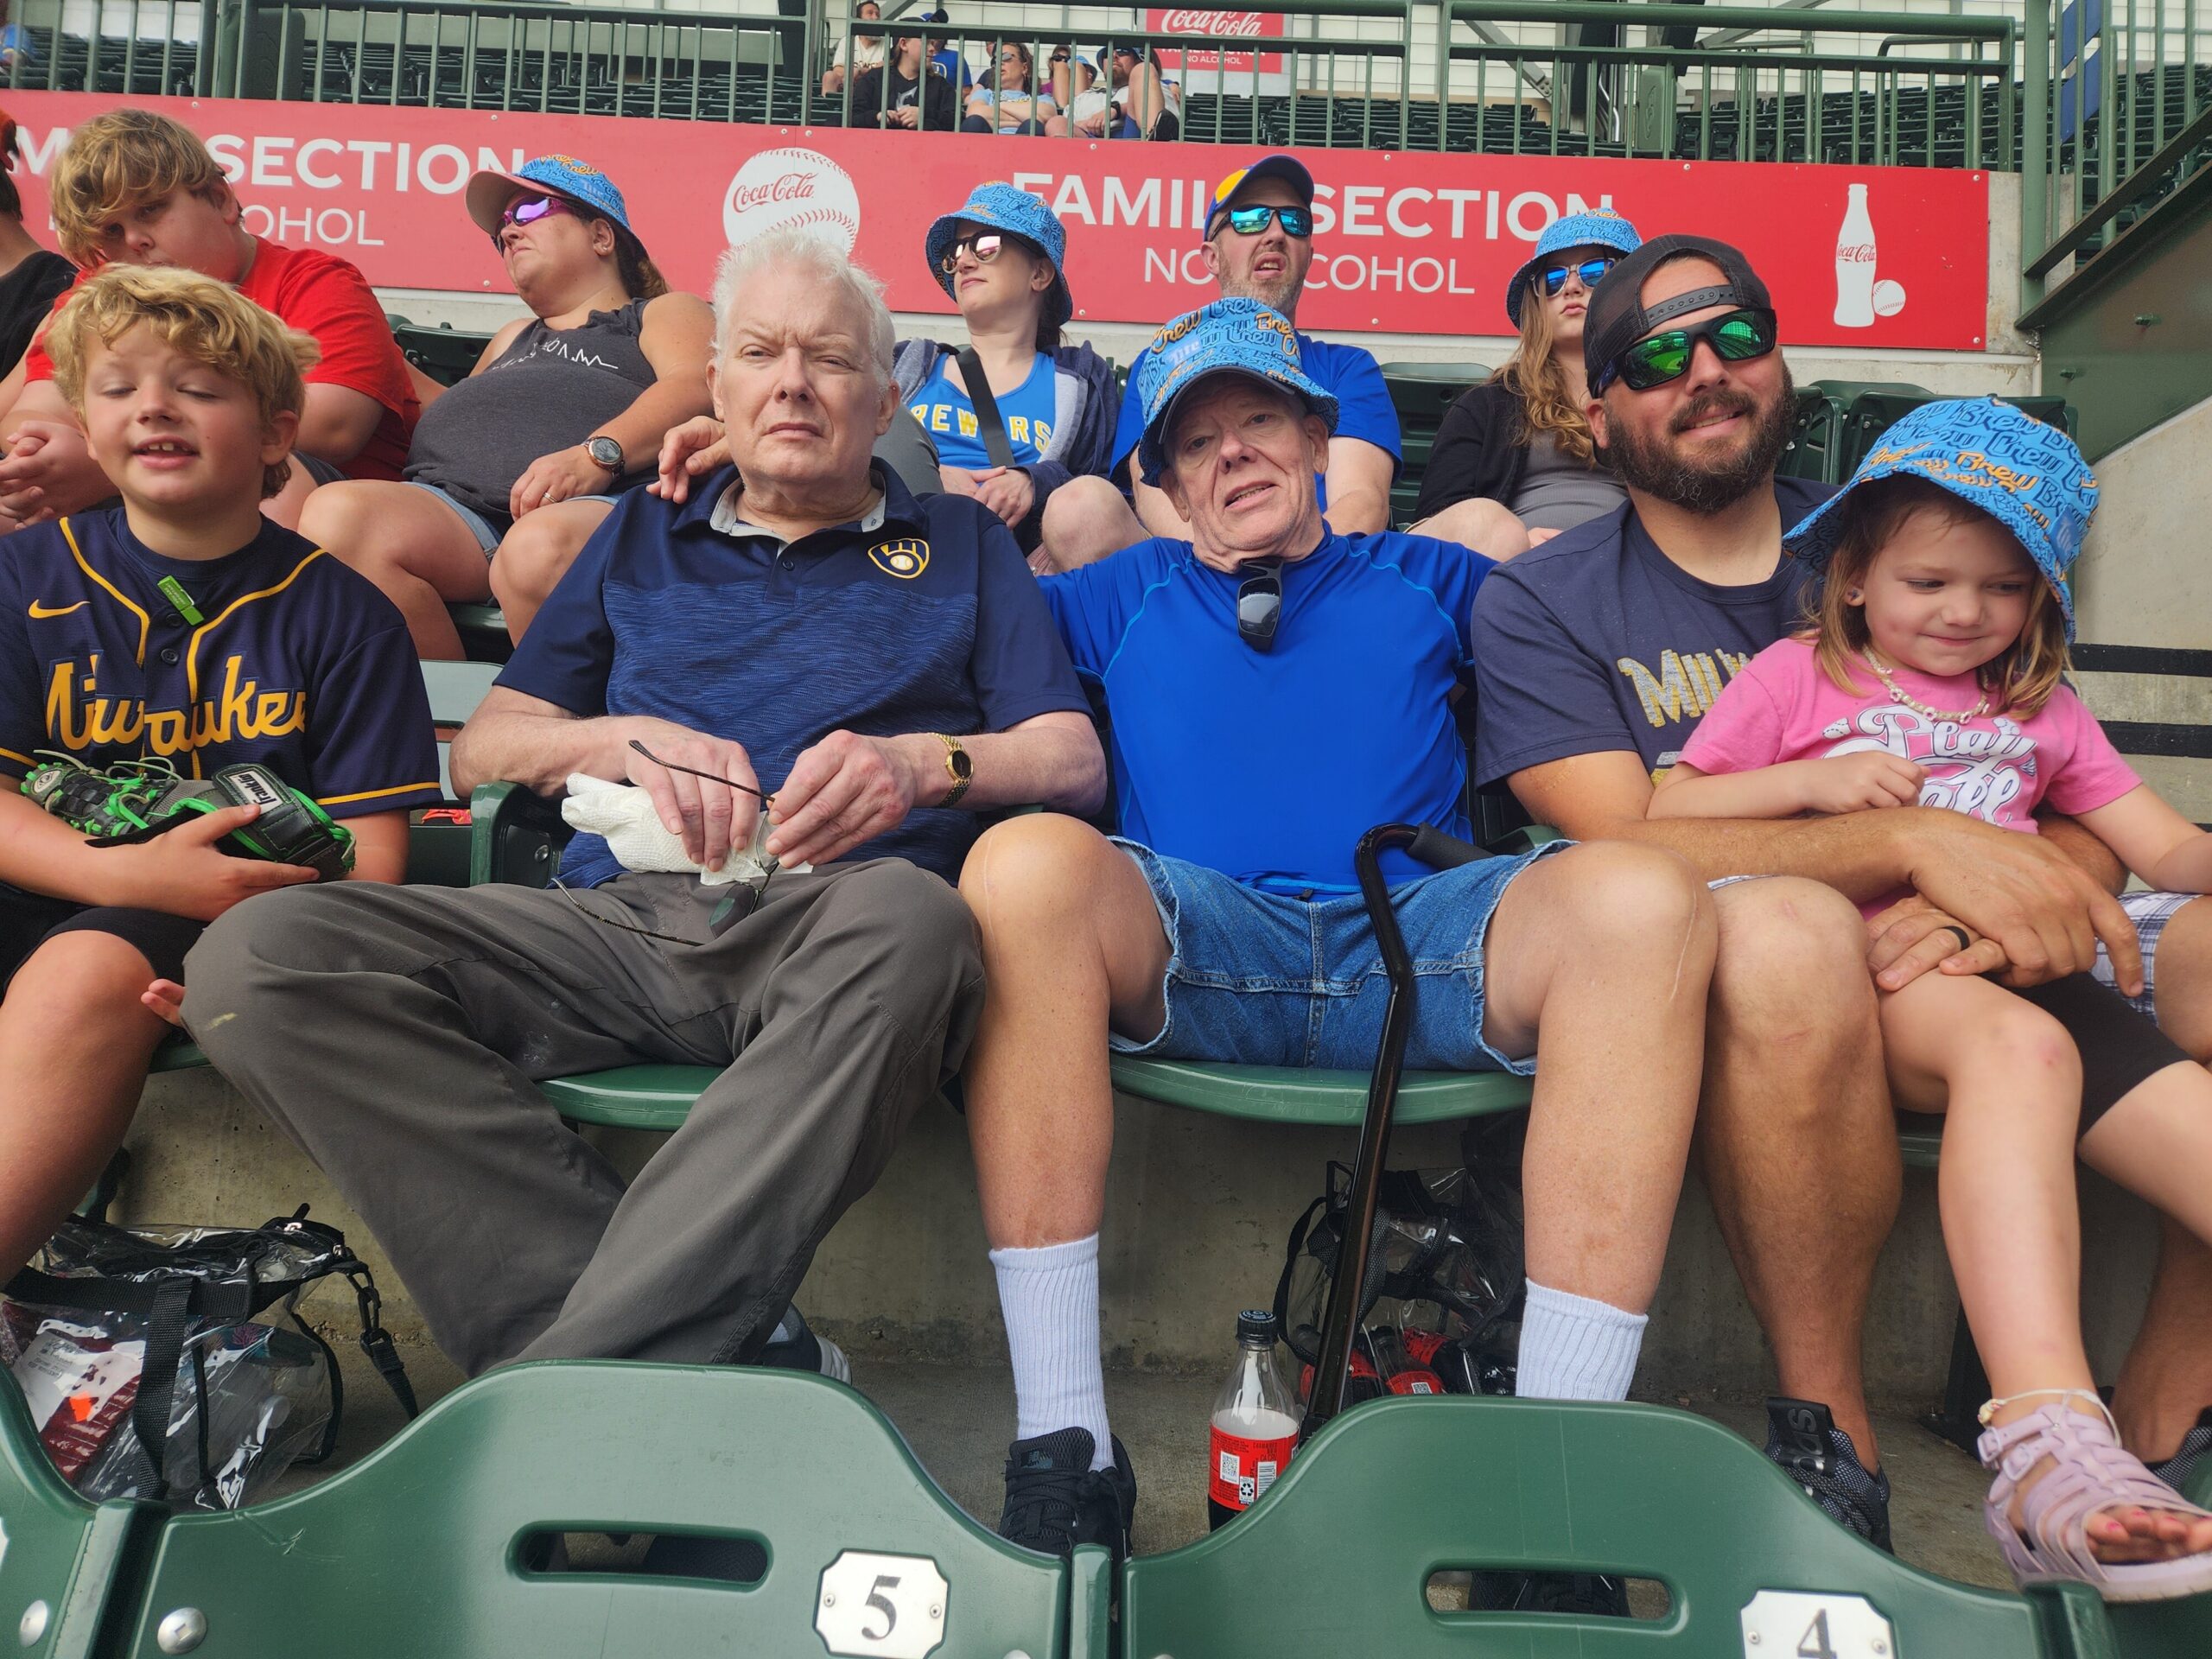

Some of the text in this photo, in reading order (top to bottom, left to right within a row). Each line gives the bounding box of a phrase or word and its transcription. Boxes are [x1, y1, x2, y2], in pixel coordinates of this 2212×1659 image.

[733, 173, 819, 213] Coca-Cola
[1303, 253, 1475, 295] COHOL
[910, 404, 1052, 454] REWRS
[861, 1573, 902, 1641] 5
[1796, 1608, 1838, 1659] 4
